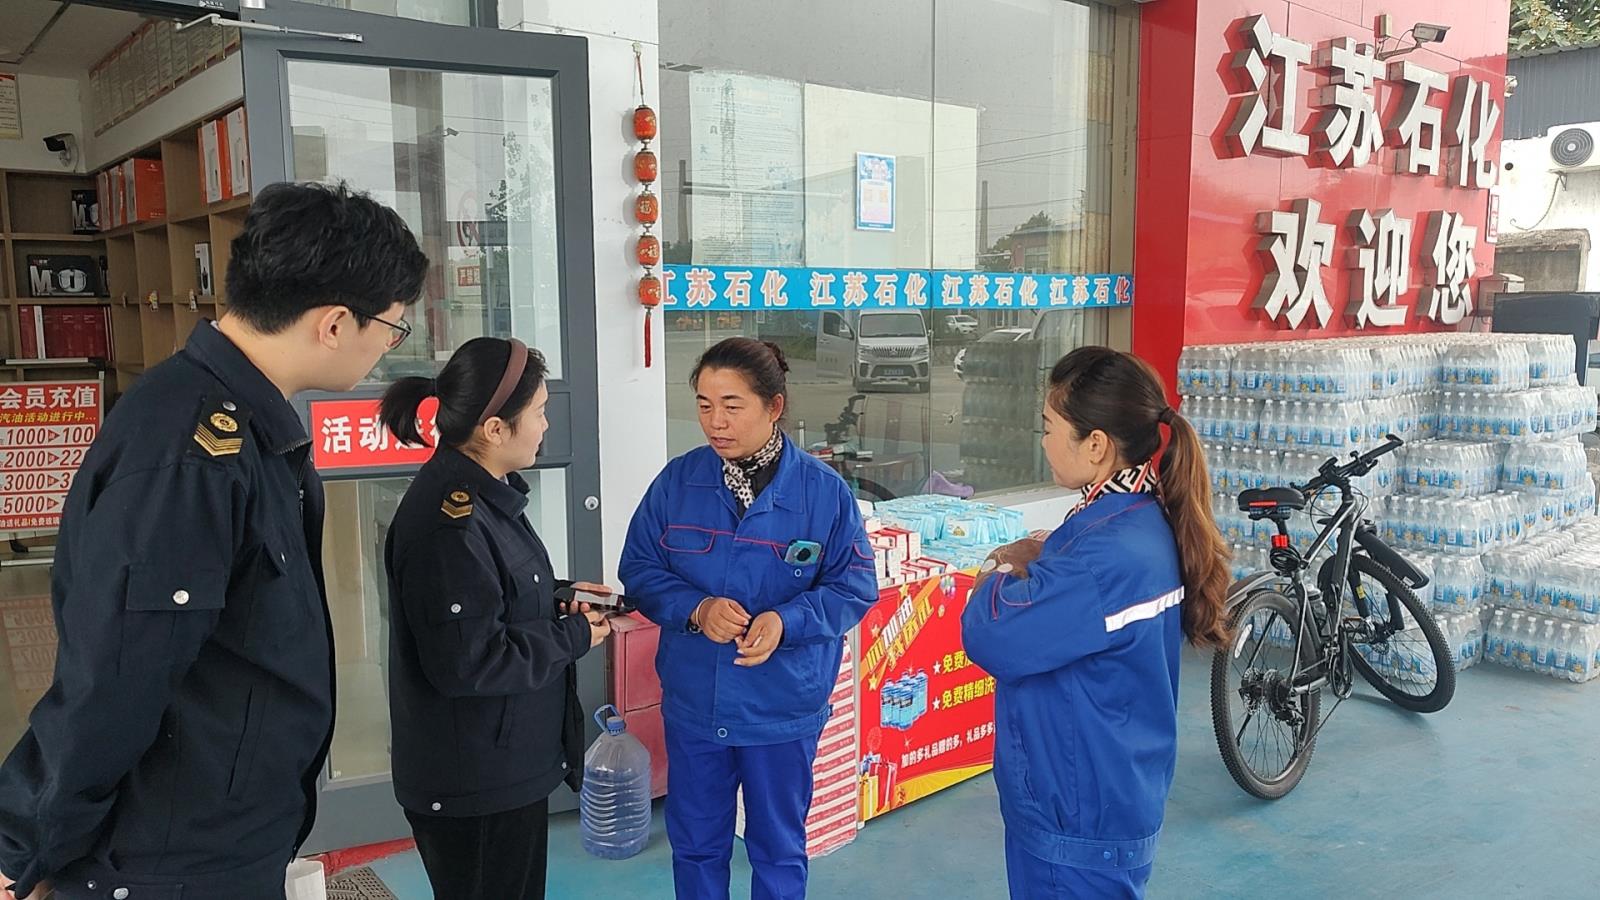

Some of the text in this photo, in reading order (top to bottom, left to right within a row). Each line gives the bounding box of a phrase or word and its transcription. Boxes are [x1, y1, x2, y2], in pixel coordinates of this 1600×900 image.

[1236, 13, 1500, 188] 江苏石化
[1262, 198, 1478, 330] 欢迎您
[810, 271, 927, 306] 江苏石化
[942, 274, 1038, 306] 江苏石化
[1050, 275, 1131, 305] 江苏石化
[1, 386, 97, 409] 会员充值
[7, 428, 45, 445] 1000
[62, 426, 94, 443] 100
[321, 415, 441, 453] 活动
[4, 451, 46, 468] 2000
[4, 473, 45, 491] 3000
[3, 496, 45, 514] 5000
[942, 650, 973, 674] 免费
